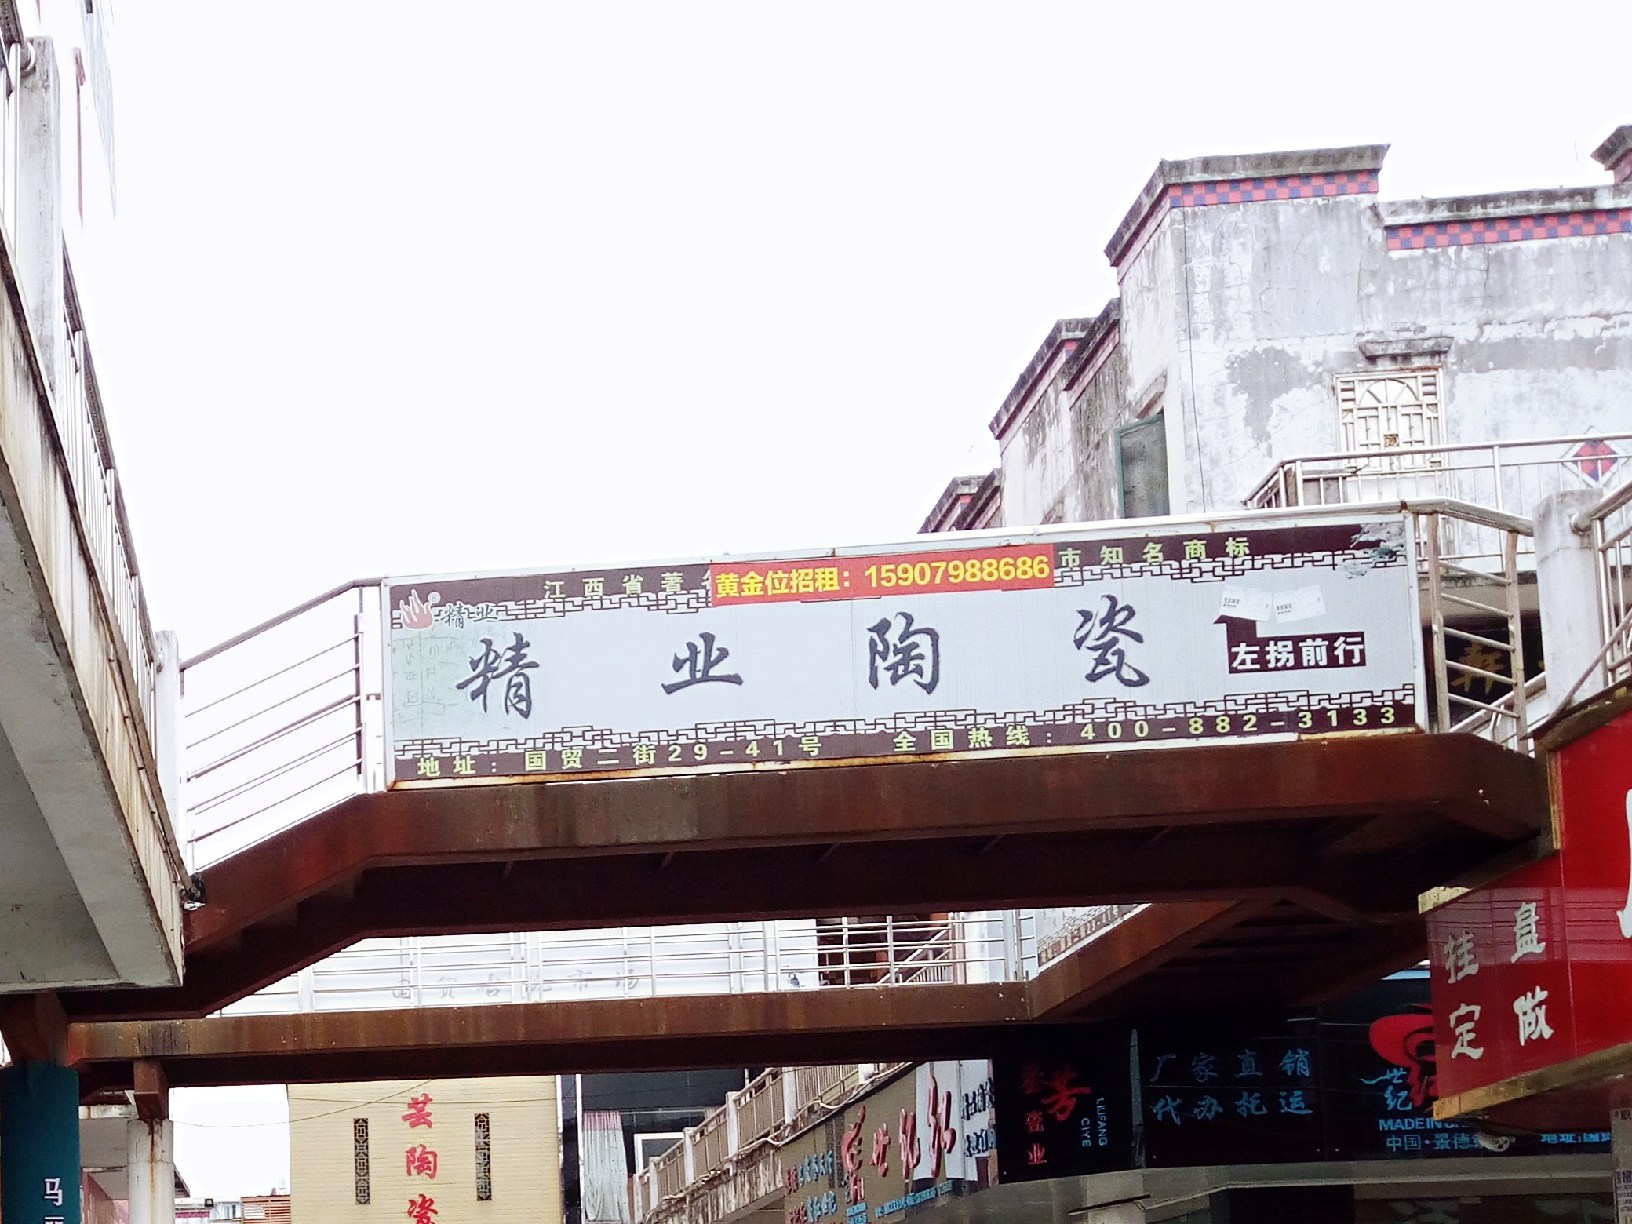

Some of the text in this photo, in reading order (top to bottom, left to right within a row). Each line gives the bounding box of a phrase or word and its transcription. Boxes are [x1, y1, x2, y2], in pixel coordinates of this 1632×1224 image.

[1058, 536, 1250, 569] 市知名商标
[455, 594, 1150, 720] 精业陶瓷
[1231, 635, 1365, 671] 左拐前行
[1149, 1047, 1312, 1084] 厂家直销
[1095, 1097, 1108, 1147] LIUFANG
[1149, 1090, 1314, 1125] 代办托运
[1080, 1117, 1092, 1147] CIYE
